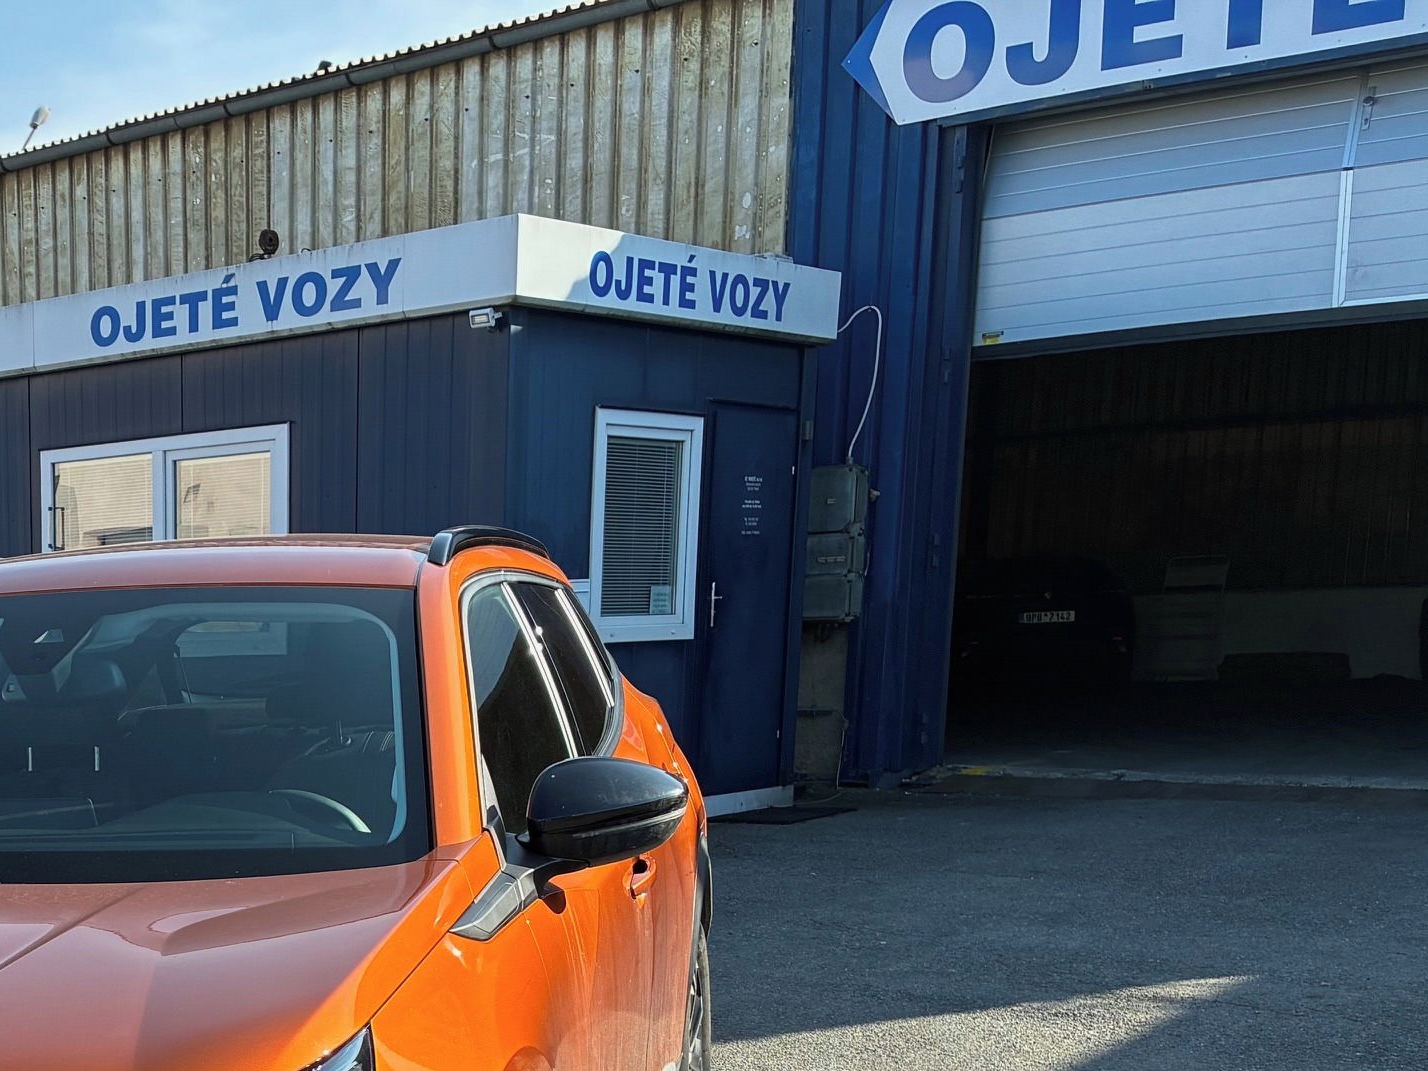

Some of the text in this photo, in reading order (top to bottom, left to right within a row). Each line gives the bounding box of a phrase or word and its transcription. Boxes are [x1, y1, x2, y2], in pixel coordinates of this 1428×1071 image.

[90, 258, 402, 347] OJETÉ VOZY
[589, 251, 791, 322] OJETÉ VOZY
